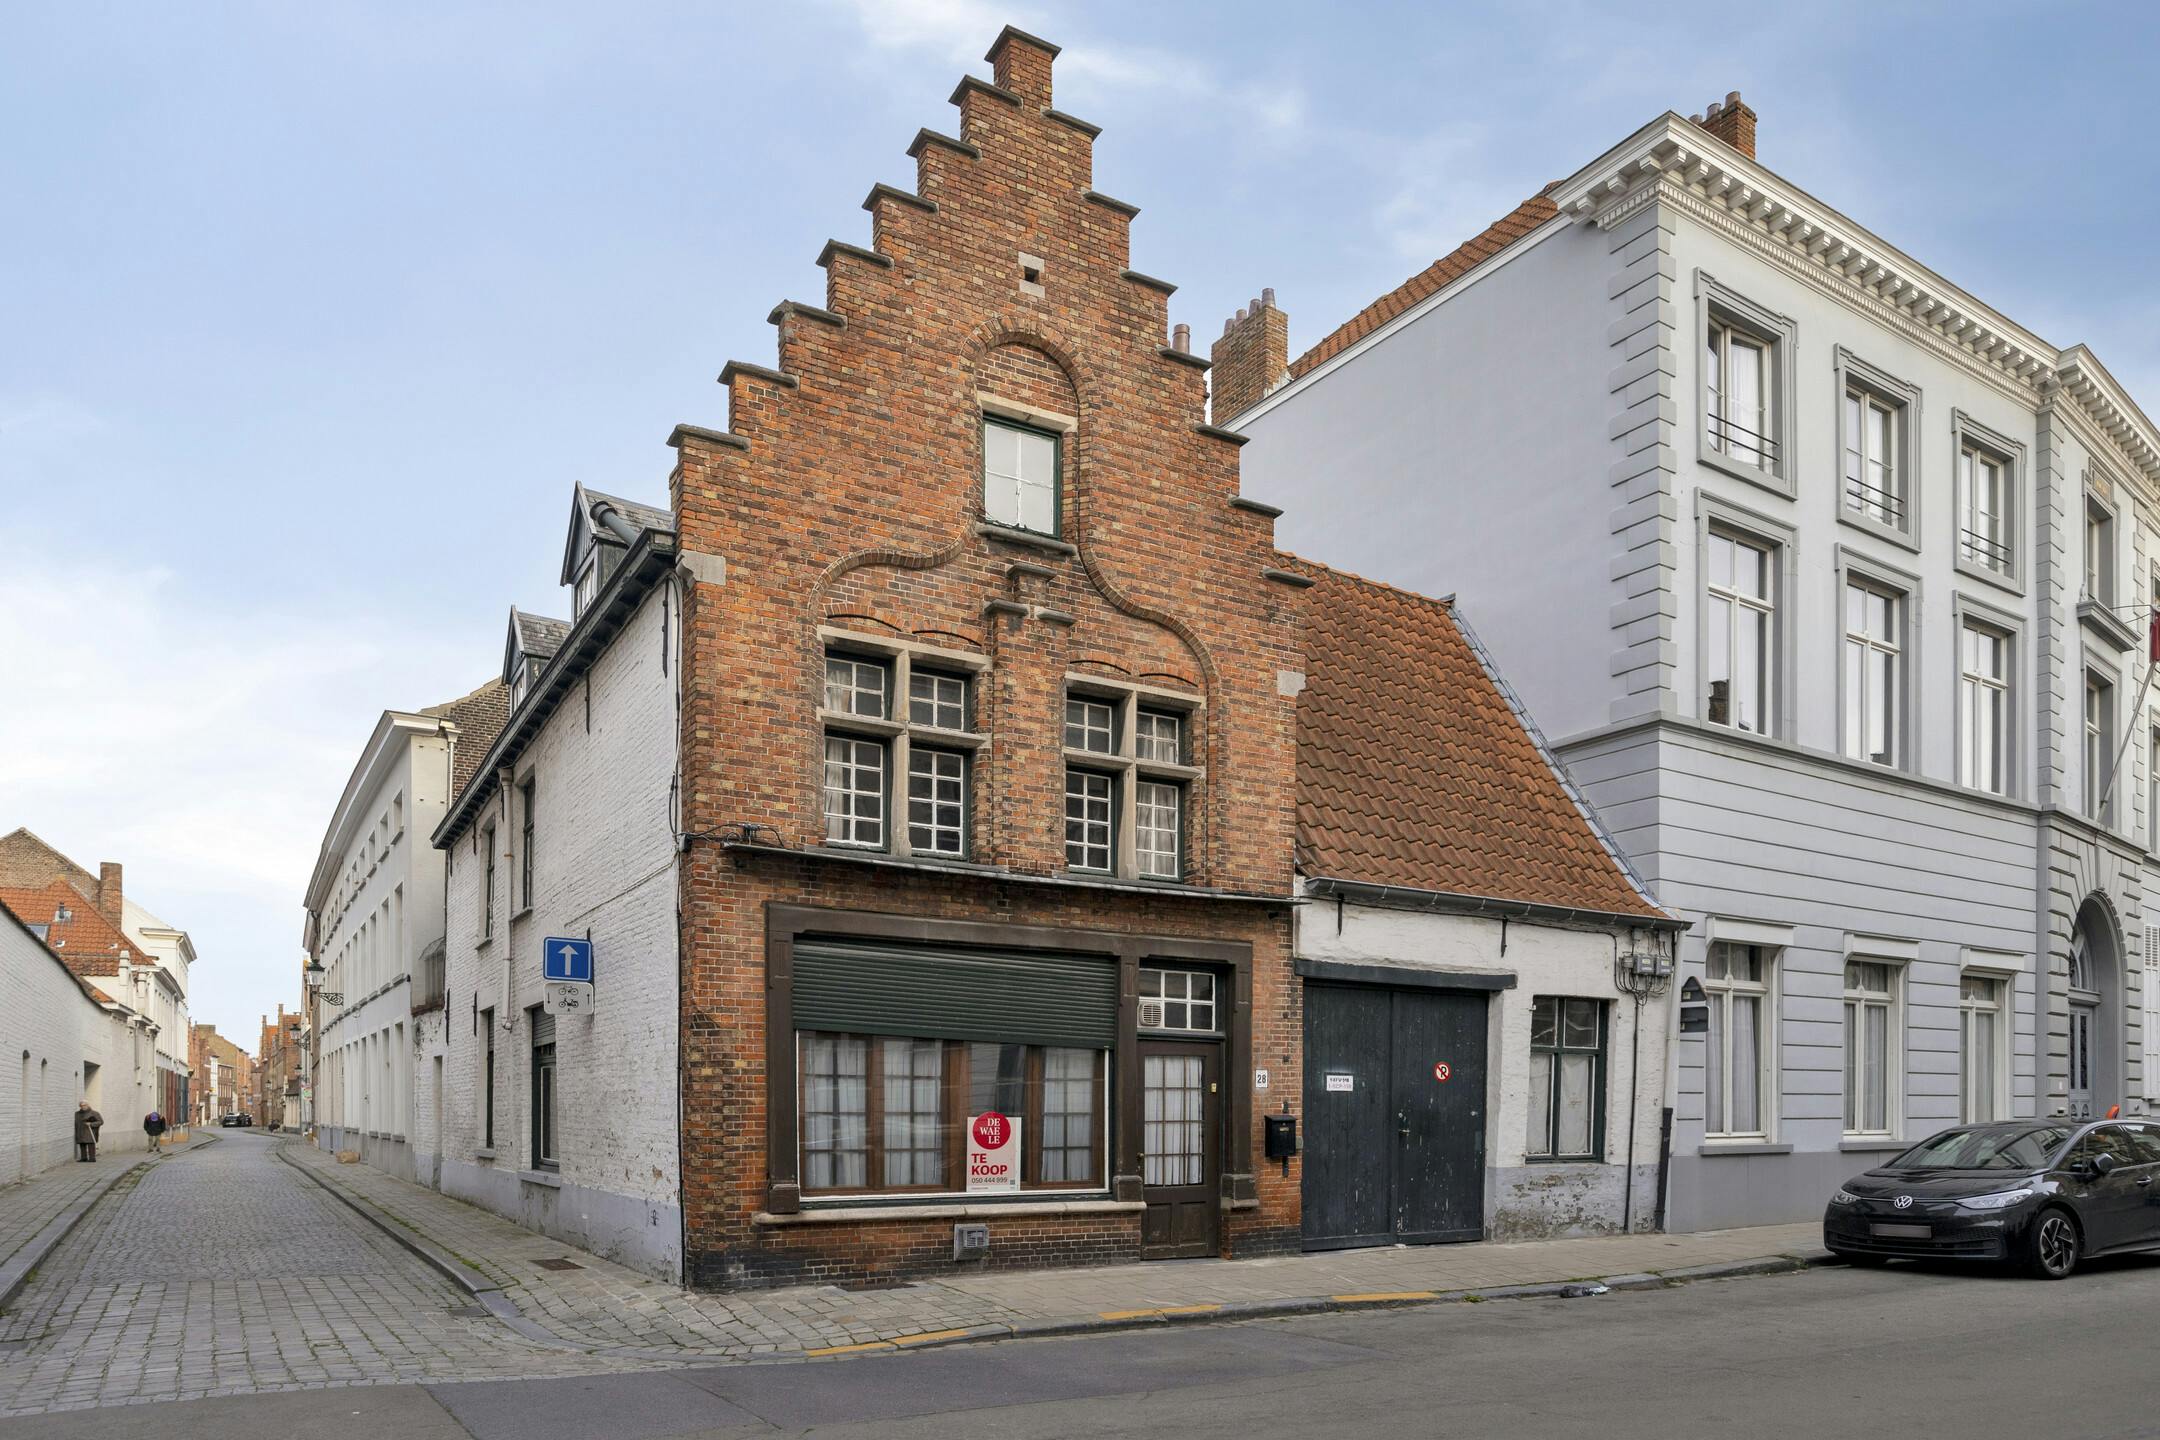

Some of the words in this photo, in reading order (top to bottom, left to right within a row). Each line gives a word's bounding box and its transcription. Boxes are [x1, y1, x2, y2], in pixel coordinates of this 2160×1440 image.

[1257, 1074, 1267, 1084] 28
[987, 1118, 1000, 1127] DE
[980, 1127, 1000, 1135] WAE
[988, 1136, 1000, 1144] LE
[971, 1153, 987, 1164] TE
[971, 1165, 1008, 1175] KOOP
